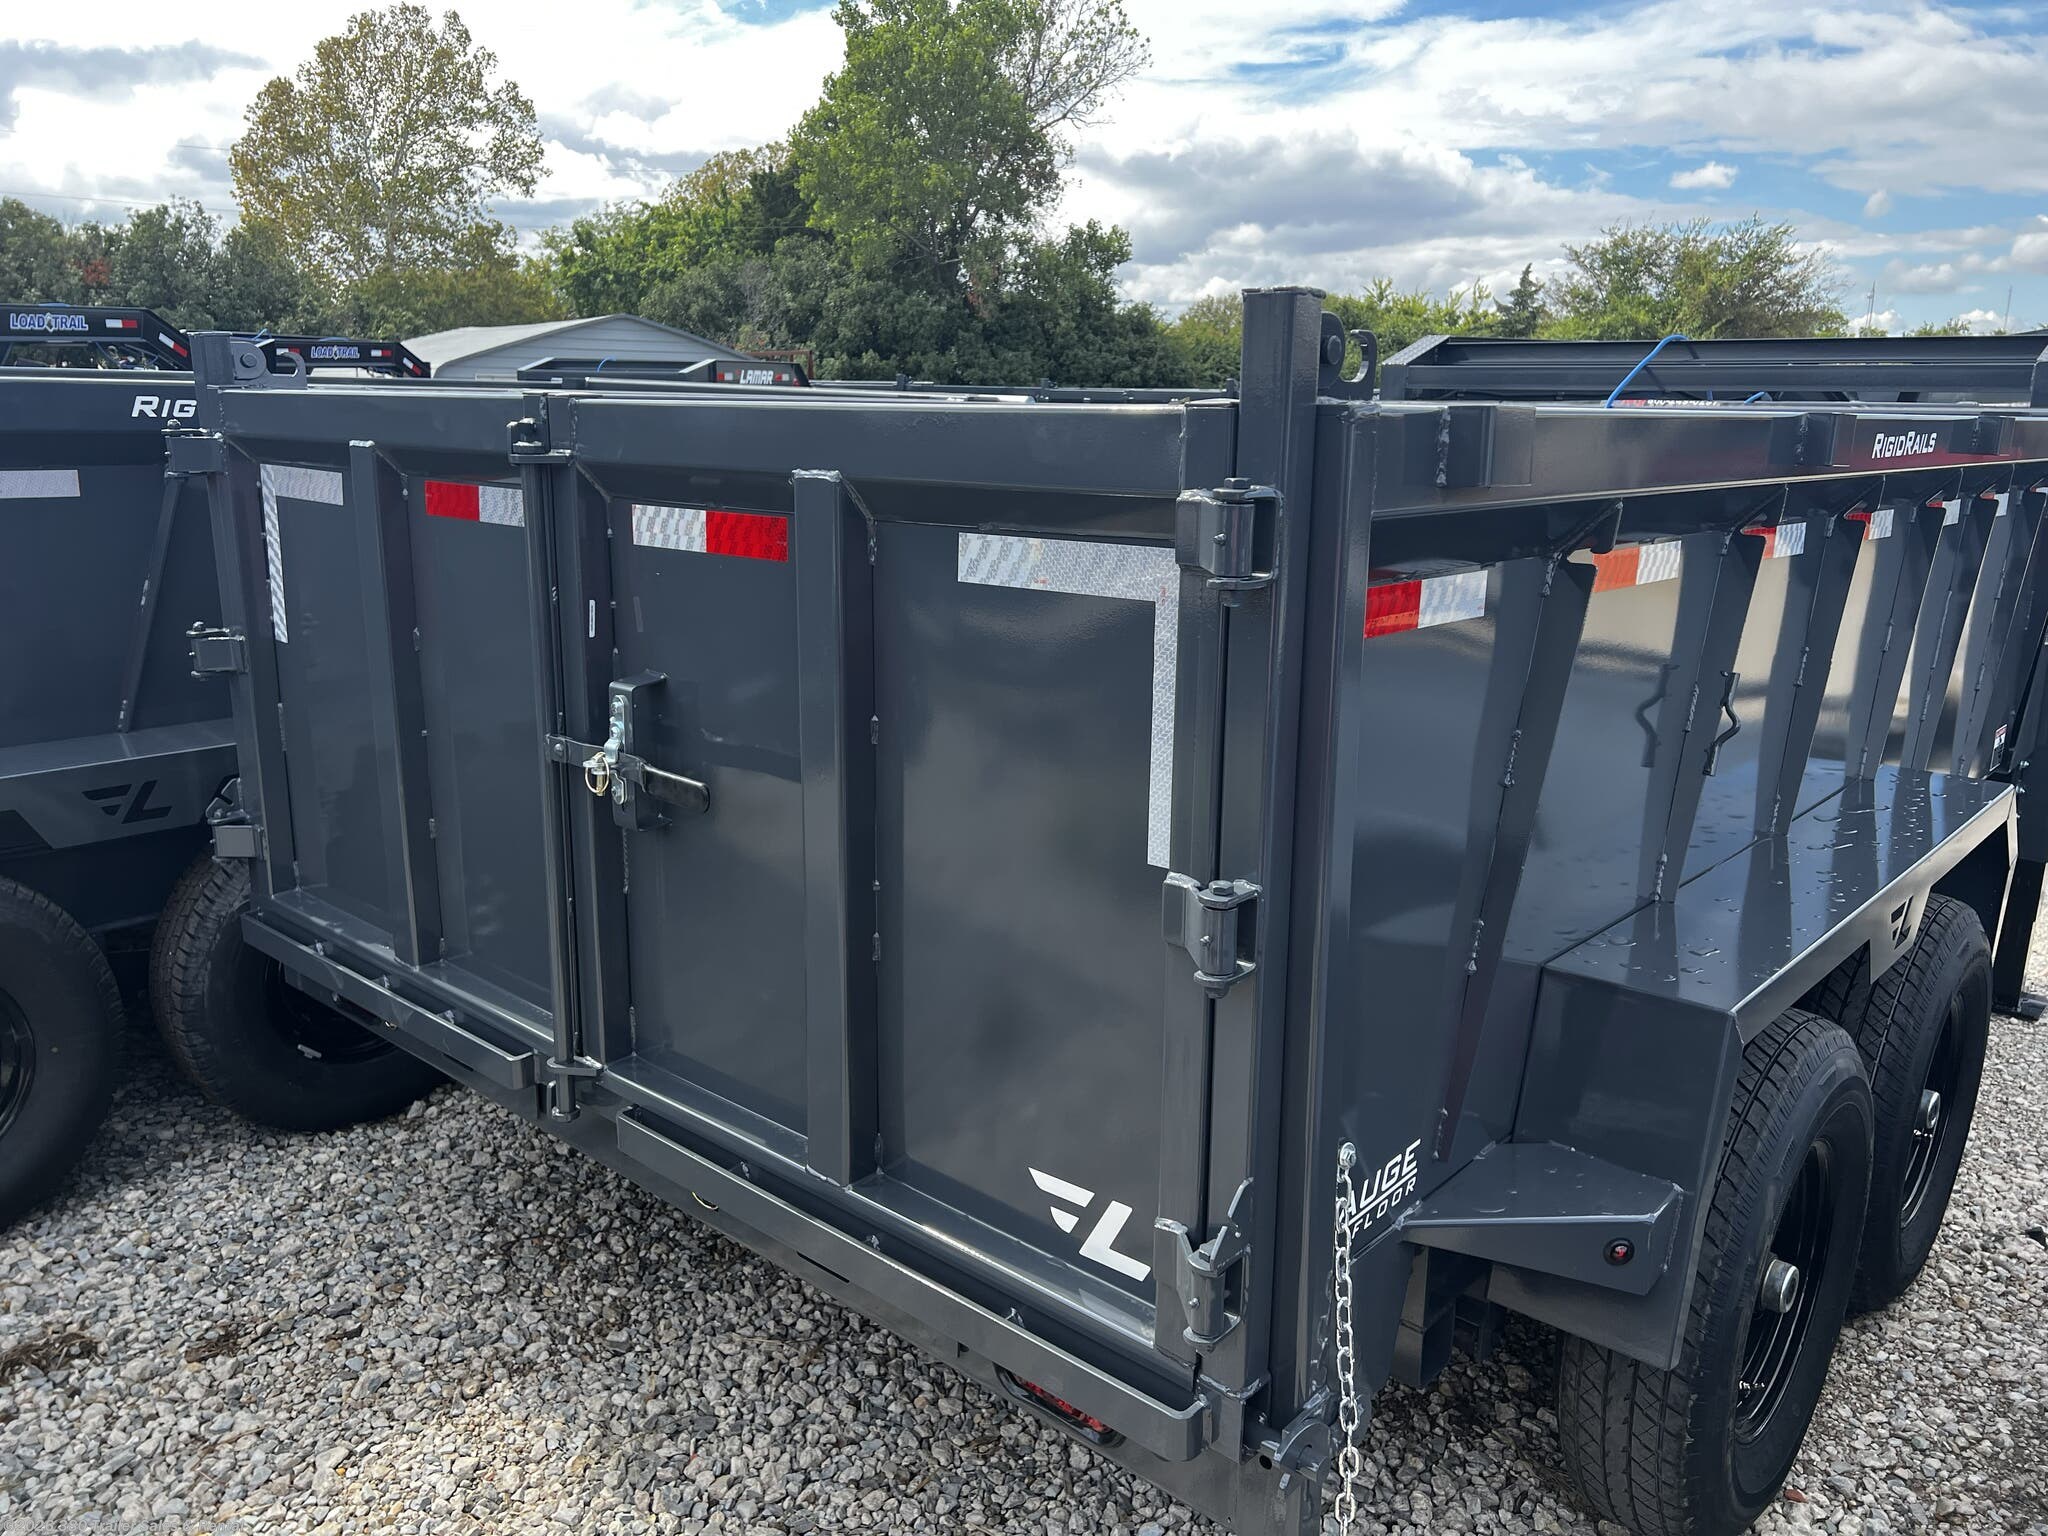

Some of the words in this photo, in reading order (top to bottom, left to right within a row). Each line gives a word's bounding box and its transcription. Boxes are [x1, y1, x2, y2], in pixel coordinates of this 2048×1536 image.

[10, 313, 46, 330] LOAD
[51, 313, 89, 331] TRAIL
[740, 369, 774, 385] LAMAR
[1351, 1176, 1417, 1239] FLOOR
